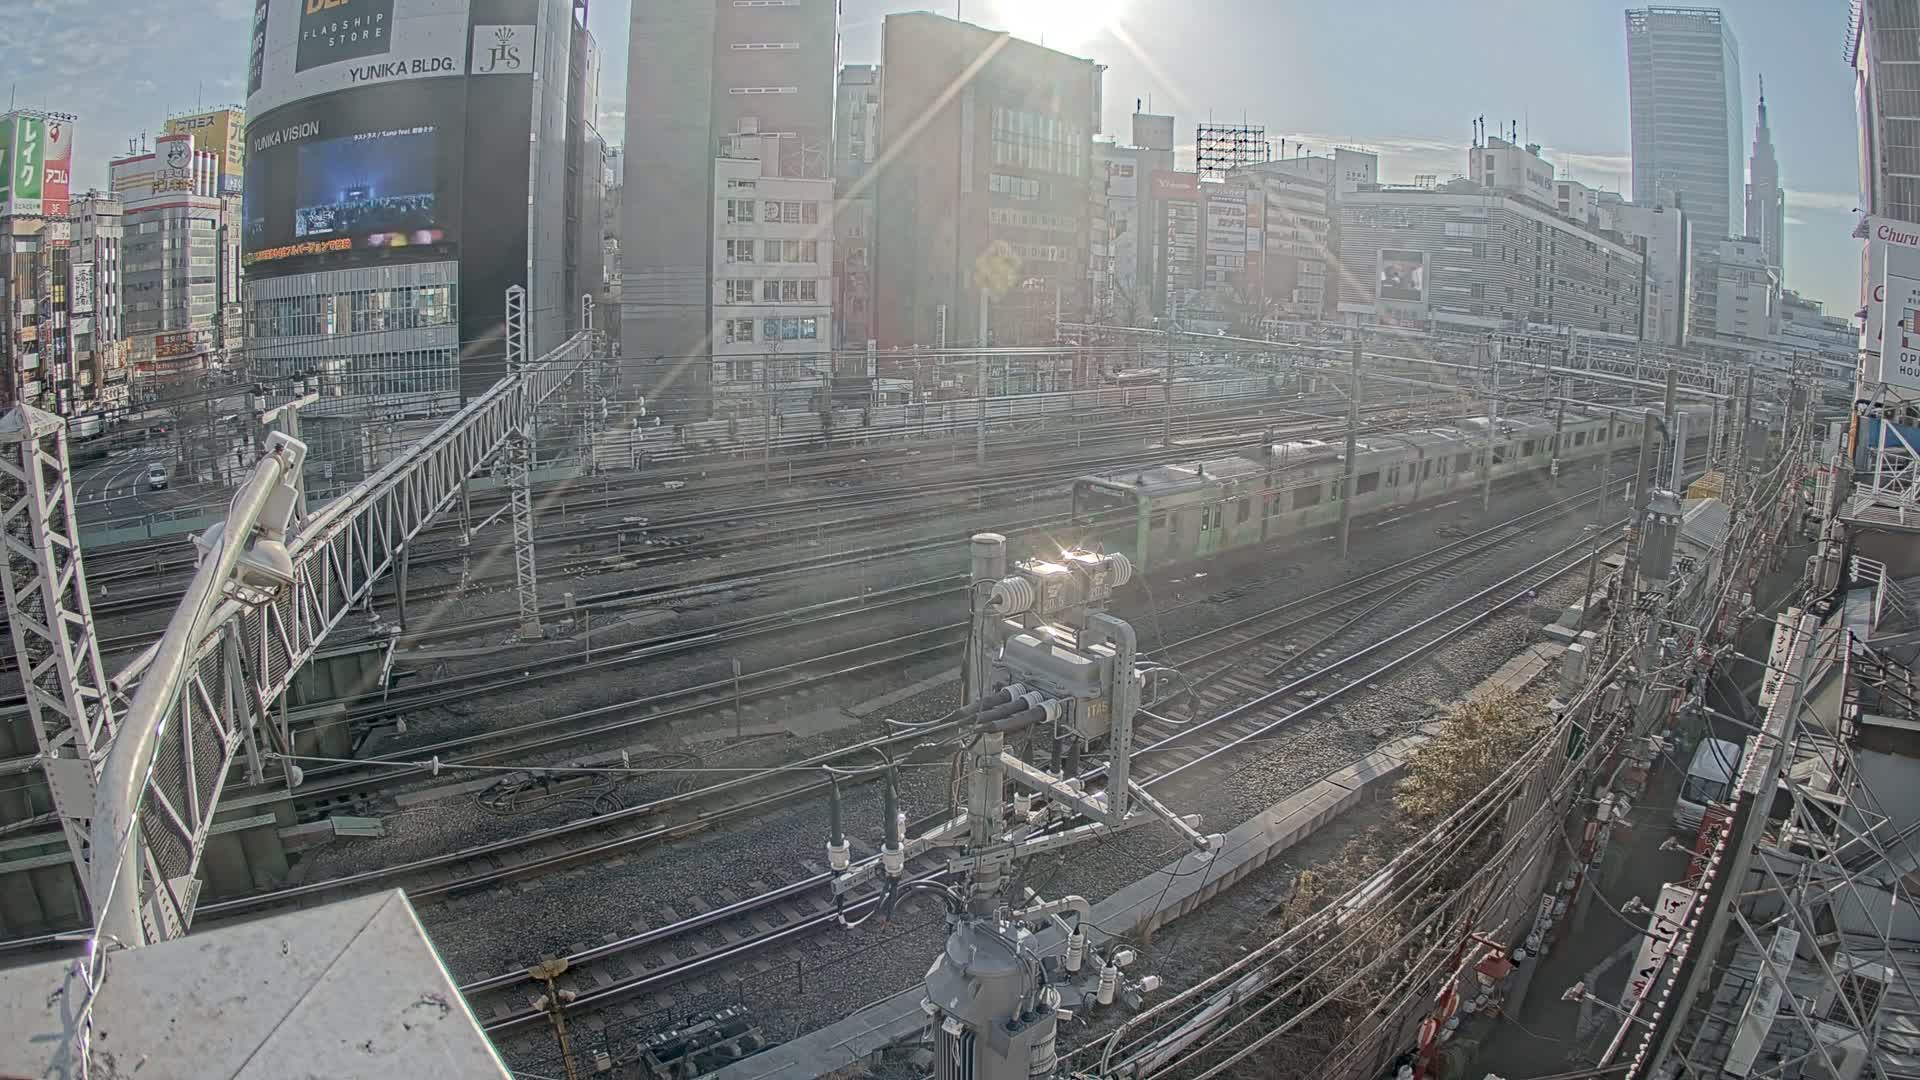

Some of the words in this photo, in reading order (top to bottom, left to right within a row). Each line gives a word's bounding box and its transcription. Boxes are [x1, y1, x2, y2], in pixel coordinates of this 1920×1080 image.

[303, 13, 383, 41] FLAGSHIP
[328, 28, 382, 47] STORE
[349, 61, 408, 82] YUNIKA
[411, 57, 456, 73] BLDG.
[254, 130, 281, 152] YUNIKA
[282, 120, 320, 144] VISION
[22, 120, 37, 187] レイク
[46, 168, 68, 185] アコム
